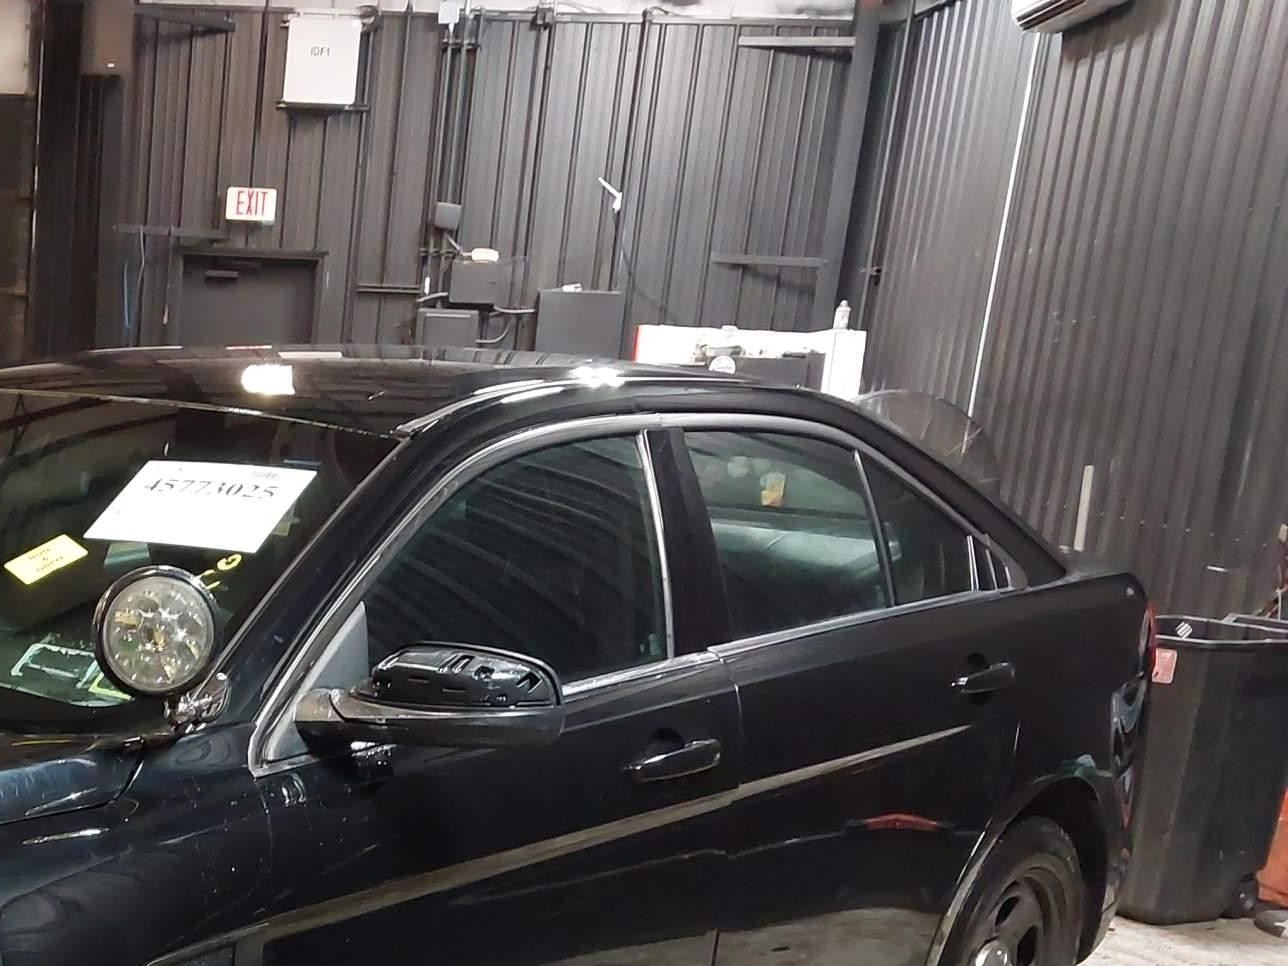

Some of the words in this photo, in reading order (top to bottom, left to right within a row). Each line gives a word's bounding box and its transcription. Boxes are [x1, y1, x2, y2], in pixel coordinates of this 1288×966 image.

[310, 46, 331, 57] IDF1
[236, 190, 268, 216] EXIT
[144, 478, 279, 500] 45773025
